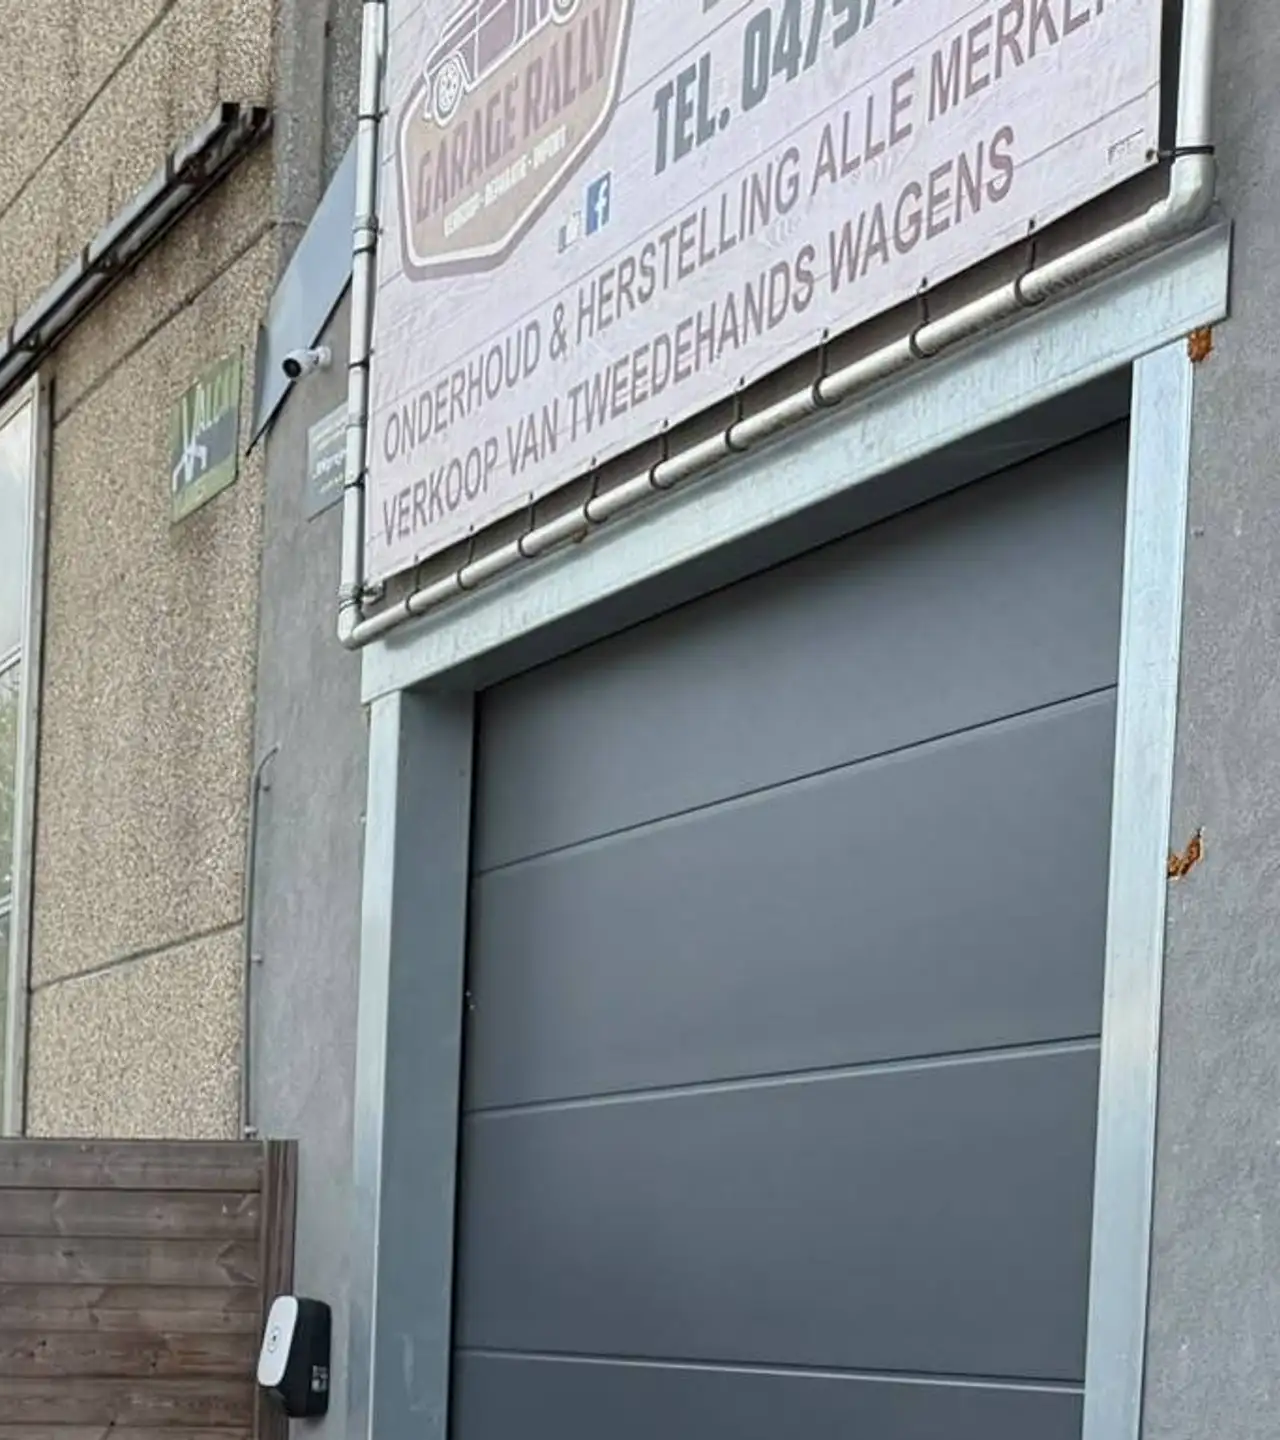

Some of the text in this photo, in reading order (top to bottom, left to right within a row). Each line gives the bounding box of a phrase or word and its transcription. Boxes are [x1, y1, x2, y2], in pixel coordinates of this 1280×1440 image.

[383, 319, 541, 463] ONDERHOUD
[549, 301, 568, 361] &
[576, 146, 800, 346] HERSTELLING
[810, 67, 914, 196] ALLE
[928, 0, 1104, 122] MERK
[416, 73, 519, 225] GARAGE
[523, 0, 617, 139] RALLY
[653, 52, 730, 176] TEL.
[383, 125, 1014, 547] VERKOOP VAN TWEEDEHANDS WAGENS
